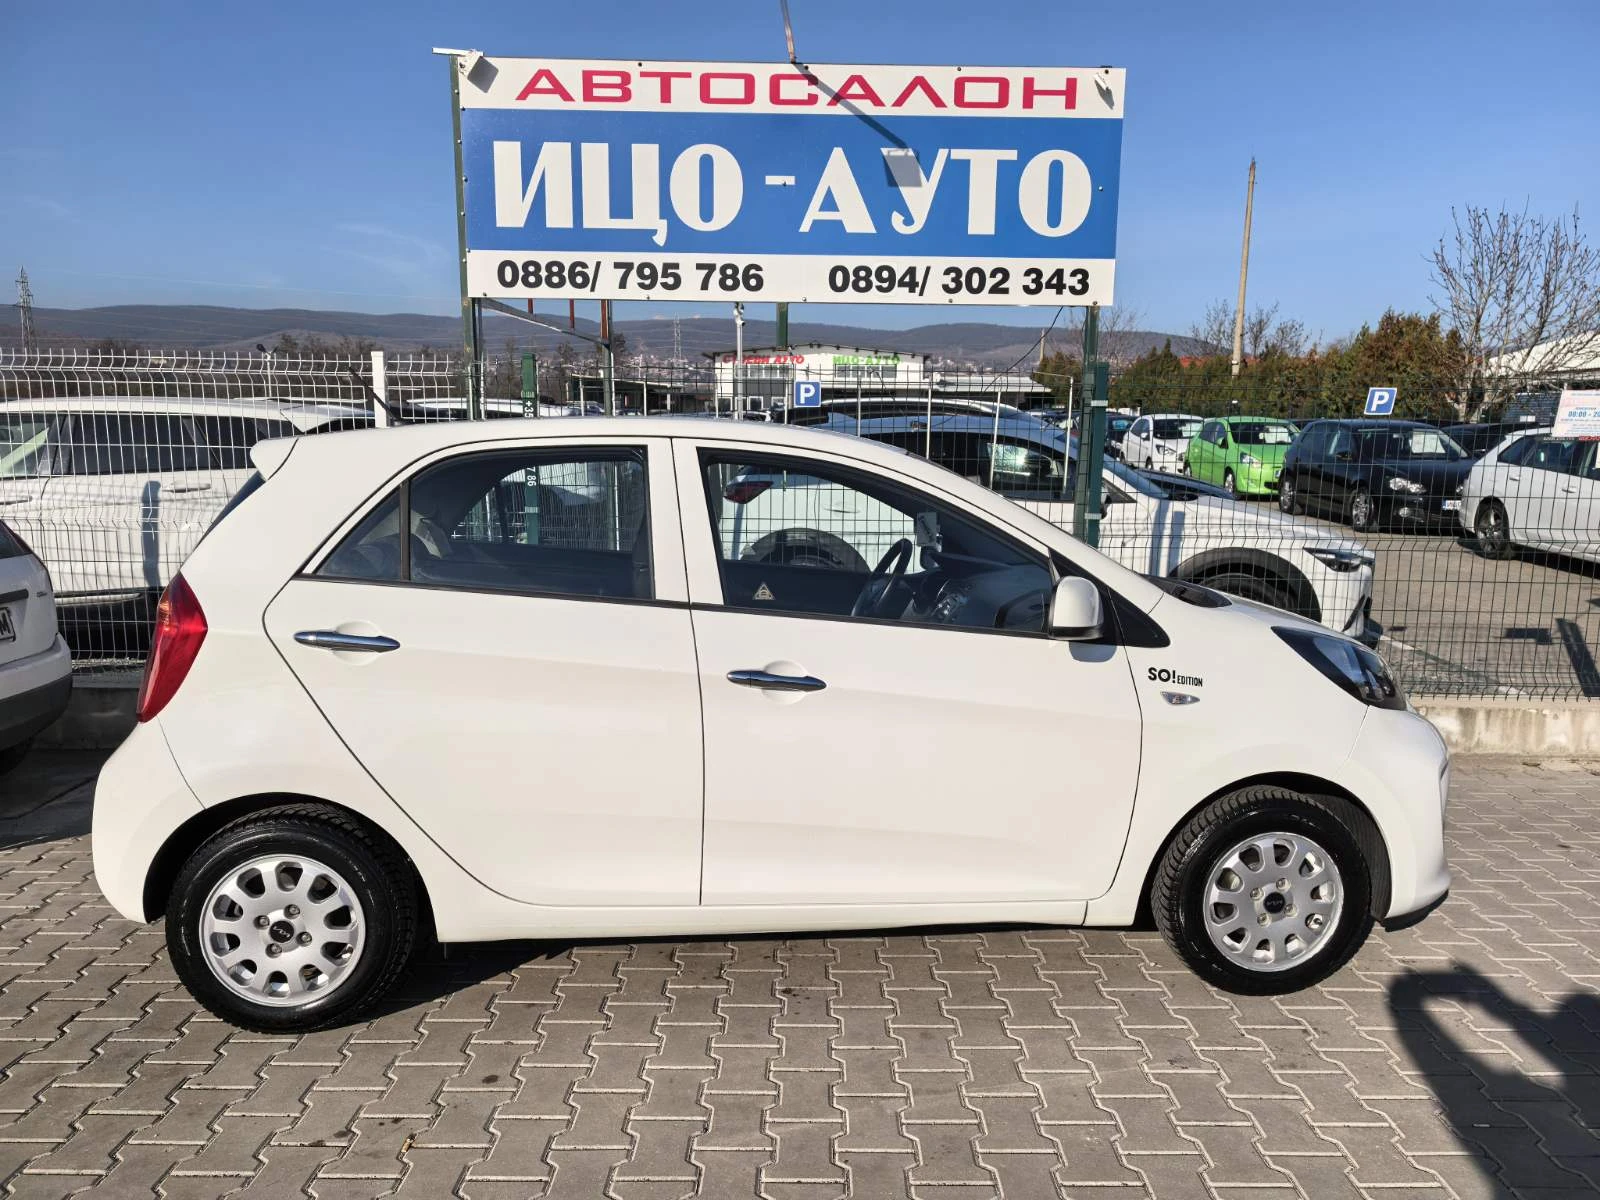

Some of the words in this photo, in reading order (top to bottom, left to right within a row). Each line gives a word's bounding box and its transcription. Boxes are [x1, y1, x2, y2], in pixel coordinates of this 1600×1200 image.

[515, 69, 1078, 110] АВТОСАЛОН
[493, 141, 744, 247] ИЦО
[497, 259, 602, 293] 0886/
[613, 262, 683, 291] 795
[695, 263, 764, 292] 786
[828, 264, 931, 296] 0894/
[941, 266, 1010, 295] 302
[1022, 267, 1089, 296] 343
[800, 384, 816, 405] P
[1370, 391, 1390, 412] P
[1148, 667, 1175, 683] SO!
[1177, 675, 1203, 687] EDITION
